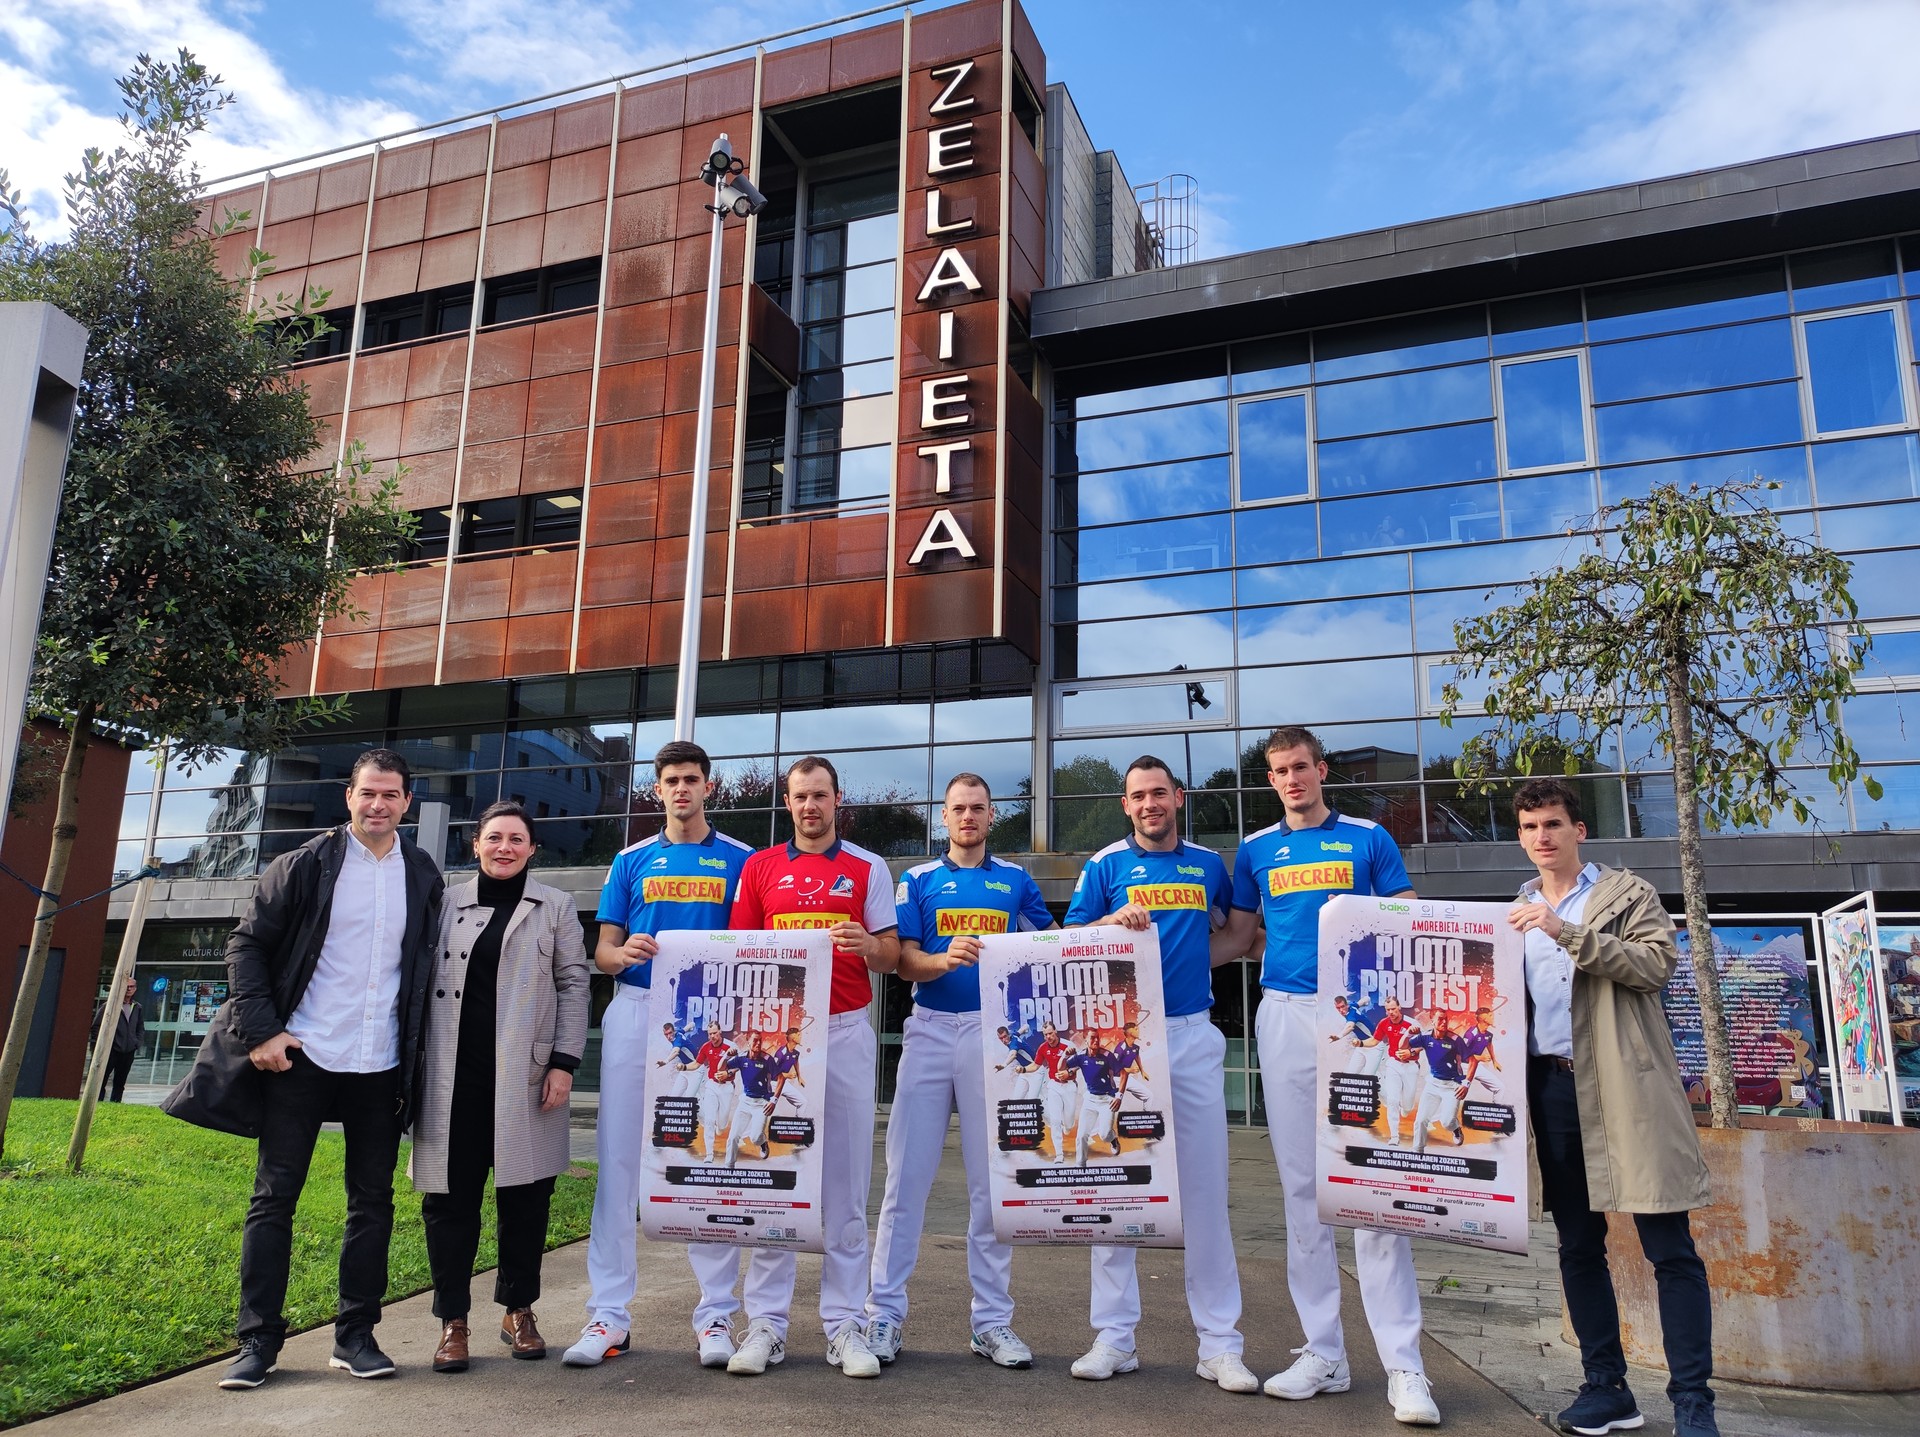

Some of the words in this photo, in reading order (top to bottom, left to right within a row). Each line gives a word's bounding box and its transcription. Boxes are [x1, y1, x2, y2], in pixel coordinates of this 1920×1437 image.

[908, 58, 982, 564] ZELAIETA
[1272, 867, 1349, 891] AVECREM
[647, 880, 722, 899] AVECREM
[1133, 889, 1204, 907] AVECREM
[1379, 902, 1410, 912] baiko
[777, 919, 838, 929] AVECRE
[940, 913, 1006, 933] AVECREM
[1412, 920, 1494, 935] AMOREBIETA-ETXANO
[1033, 934, 1059, 942] baiko
[736, 948, 807, 960] AMOREBIETA-ETXANO
[1062, 943, 1134, 958] AMOREBIETA-ETXANO
[1376, 935, 1463, 975] PILOTA
[702, 964, 779, 997] PILOTA
[1031, 961, 1109, 997] PILOTA
[1360, 969, 1415, 1008] PRO
[1422, 973, 1481, 1012] FEST
[686, 996, 735, 1032] PRO
[741, 997, 793, 1033] FEST
[1019, 996, 1069, 1031] PRO
[1074, 993, 1126, 1030] FEST
[1334, 1086, 1368, 1094] URTARRILAK
[1341, 1095, 1368, 1103] OTSAILAK
[1338, 1104, 1364, 1112] OTSAILAK
[1373, 1150, 1438, 1163] KIROL-MATERIALAREN
[1439, 1156, 1466, 1166] ZOZKETA
[690, 1168, 747, 1177] KIROL-MATERIALAREN
[747, 1170, 770, 1178] ZOZKETA
[1041, 1168, 1099, 1176] KIROL-MATERIALAREN
[1100, 1167, 1124, 1175] ZOZKETA
[1378, 1158, 1401, 1167] MUSIKA
[1402, 1161, 1431, 1170] DJ-arekin
[1431, 1164, 1470, 1174] OSTIRALERO
[694, 1176, 714, 1184] MUSIKA
[741, 1177, 773, 1185] OSTIRALERO
[1046, 1176, 1067, 1184] MUSIKA
[1094, 1174, 1128, 1182] OSTIRALERO
[1404, 1174, 1435, 1183] SARRERAK
[1404, 1203, 1435, 1212] SARRERAK
